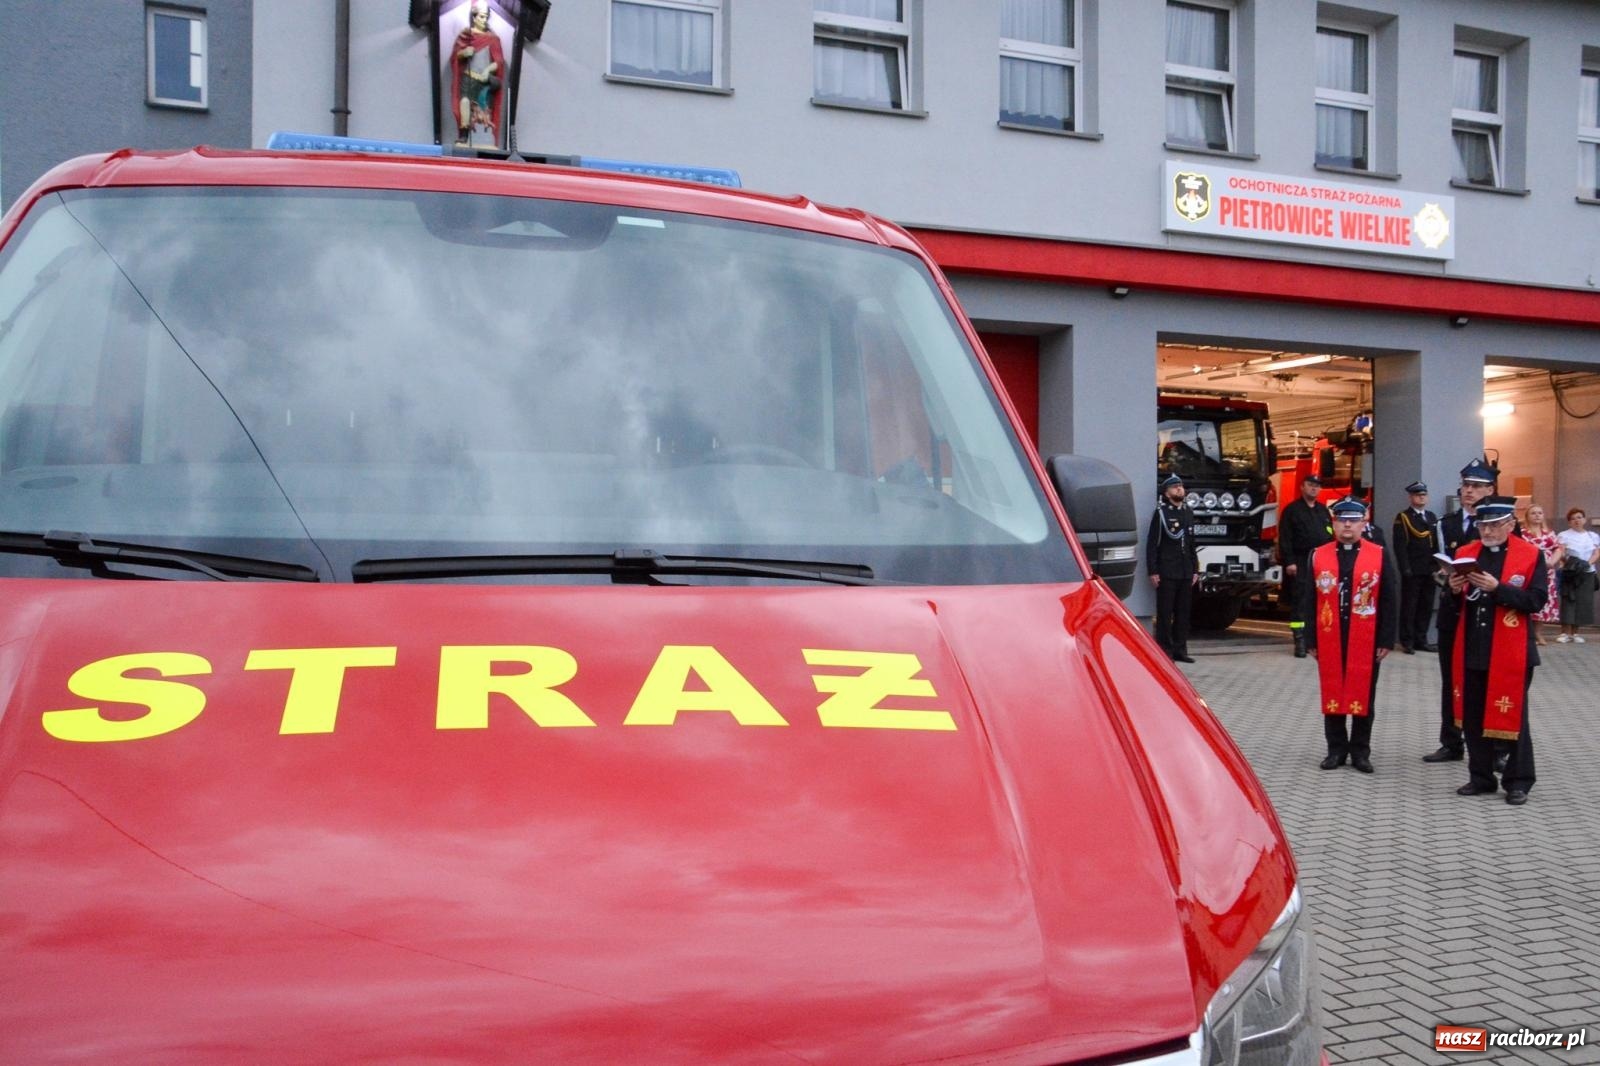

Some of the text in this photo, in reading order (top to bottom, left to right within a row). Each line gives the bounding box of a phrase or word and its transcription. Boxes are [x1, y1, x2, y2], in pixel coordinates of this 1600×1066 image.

[1228, 176, 1309, 198] OCHOTNICZA
[1348, 190, 1402, 208] POŻARNA
[1219, 195, 1411, 246] PIETROWICE WIELKIE
